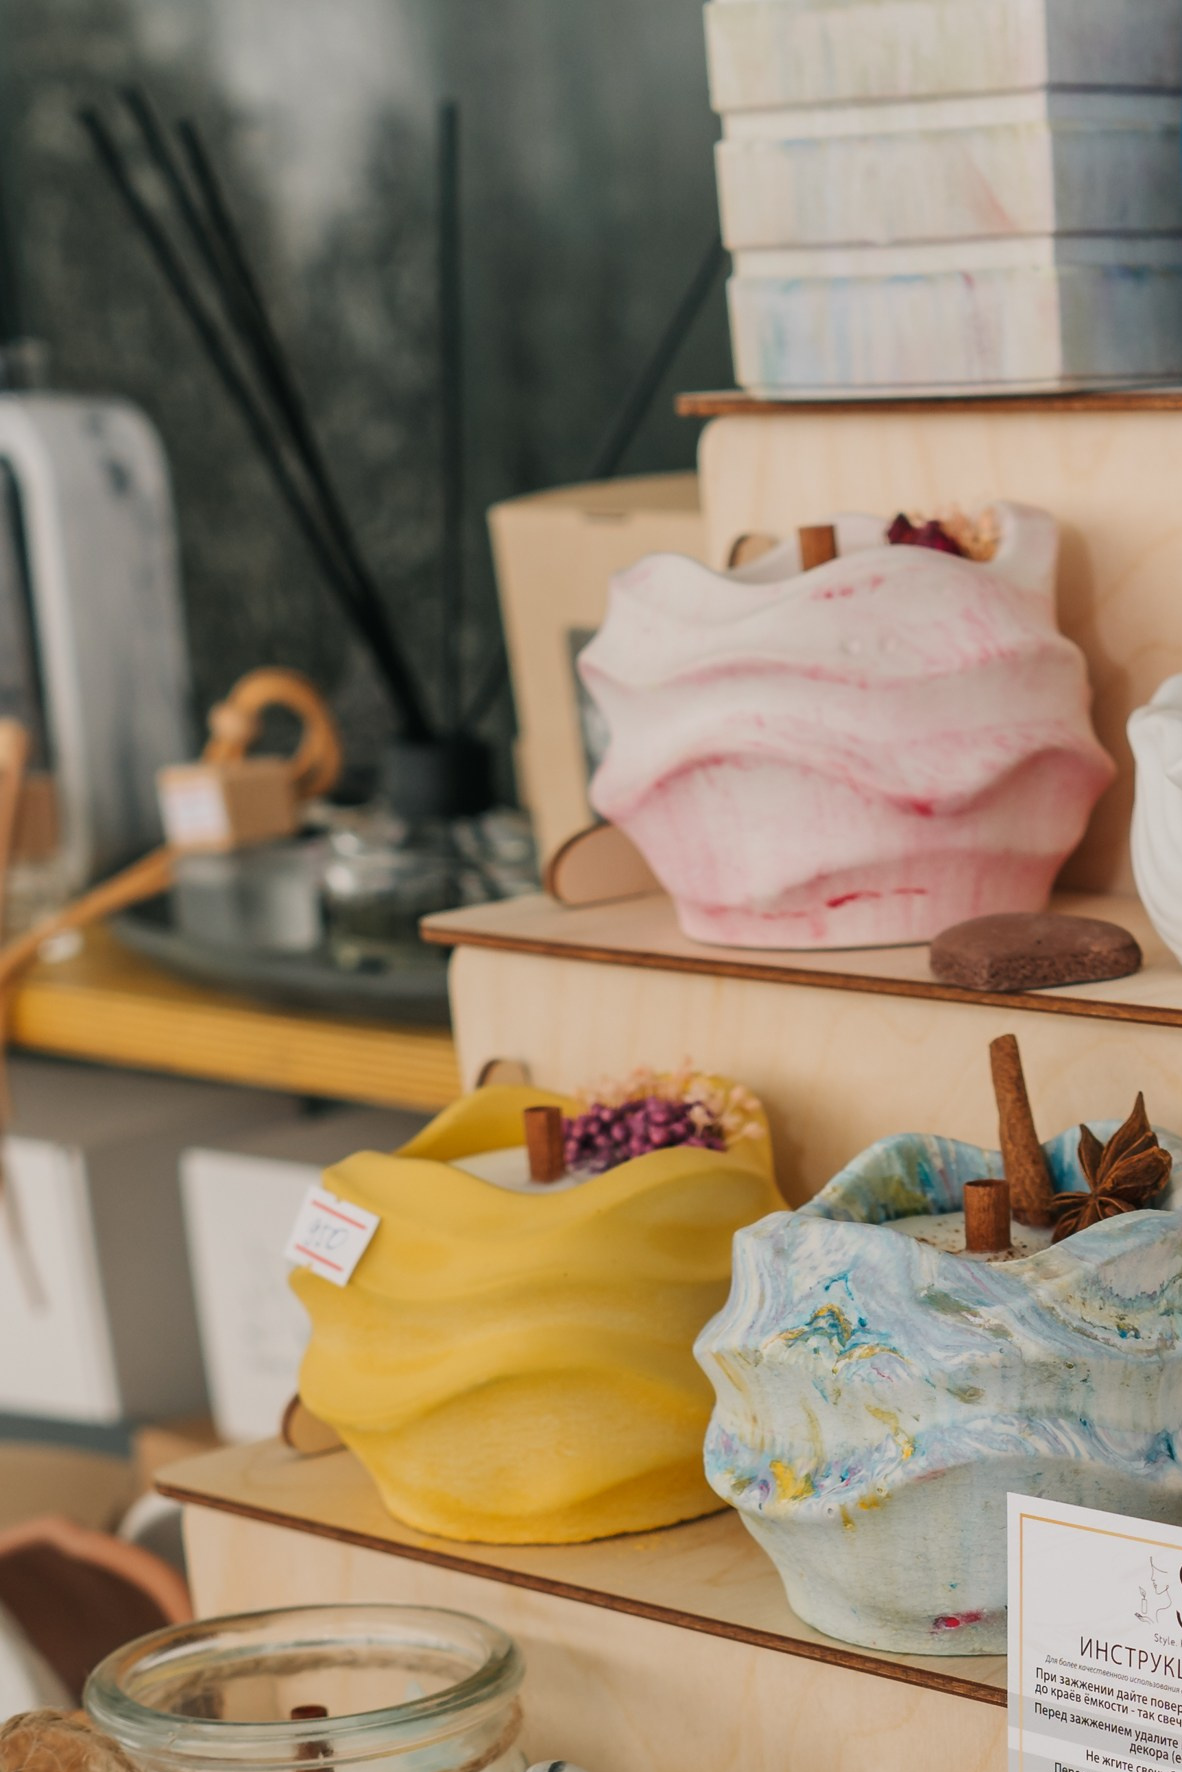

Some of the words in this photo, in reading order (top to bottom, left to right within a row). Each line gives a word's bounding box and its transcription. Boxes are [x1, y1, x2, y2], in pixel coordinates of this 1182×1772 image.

[1153, 1632, 1178, 1648] Style.
[1035, 1666, 1057, 1684] При
[1058, 1675, 1116, 1700] зажжении
[1115, 1689, 1149, 1706] дайте
[1034, 1683, 1049, 1696] до
[1050, 1686, 1082, 1703] краёв
[1083, 1692, 1129, 1715] ёмкости
[1136, 1708, 1156, 1722] так
[1034, 1701, 1068, 1724] Перед
[1069, 1713, 1133, 1738] зажжением
[1134, 1729, 1179, 1753] удалите
[1085, 1748, 1101, 1764] Не
[1100, 1755, 1134, 1772] жгите
[1128, 1742, 1169, 1762] декора
